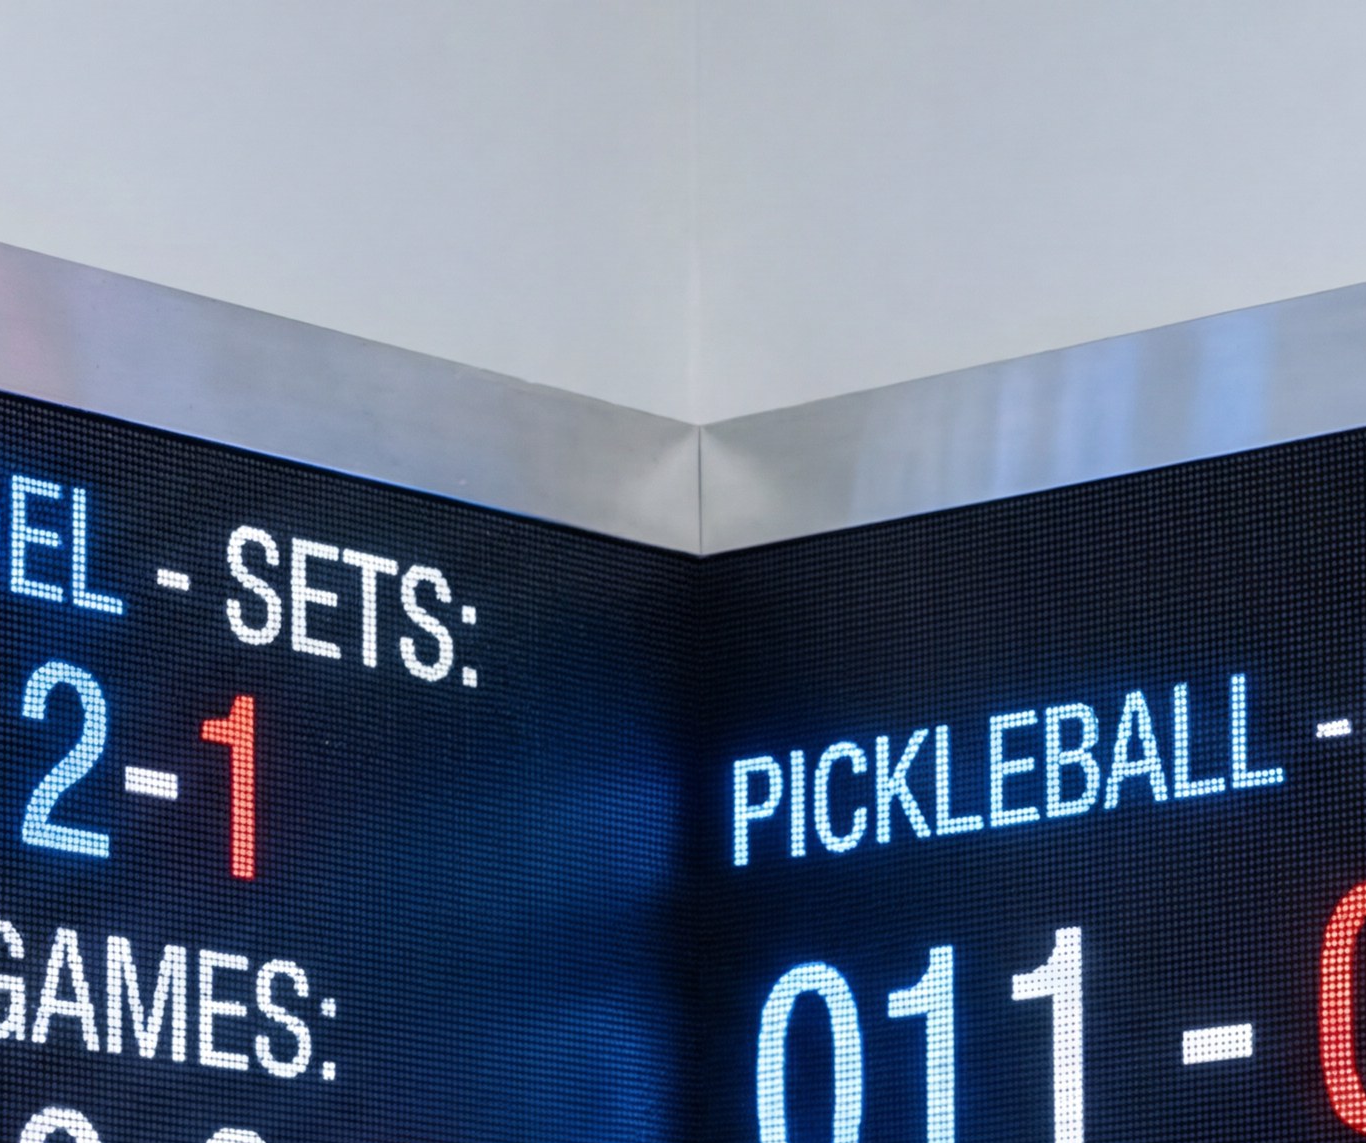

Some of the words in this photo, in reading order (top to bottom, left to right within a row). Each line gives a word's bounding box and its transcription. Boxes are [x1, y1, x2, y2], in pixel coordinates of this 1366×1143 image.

[155, 567, 192, 593] -
[224, 523, 479, 689] SETS:
[18, 658, 257, 880] 2-1
[730, 671, 1286, 867] PICKLEBALL
[1314, 716, 1354, 740] -
[1180, 1021, 1256, 1067] -
